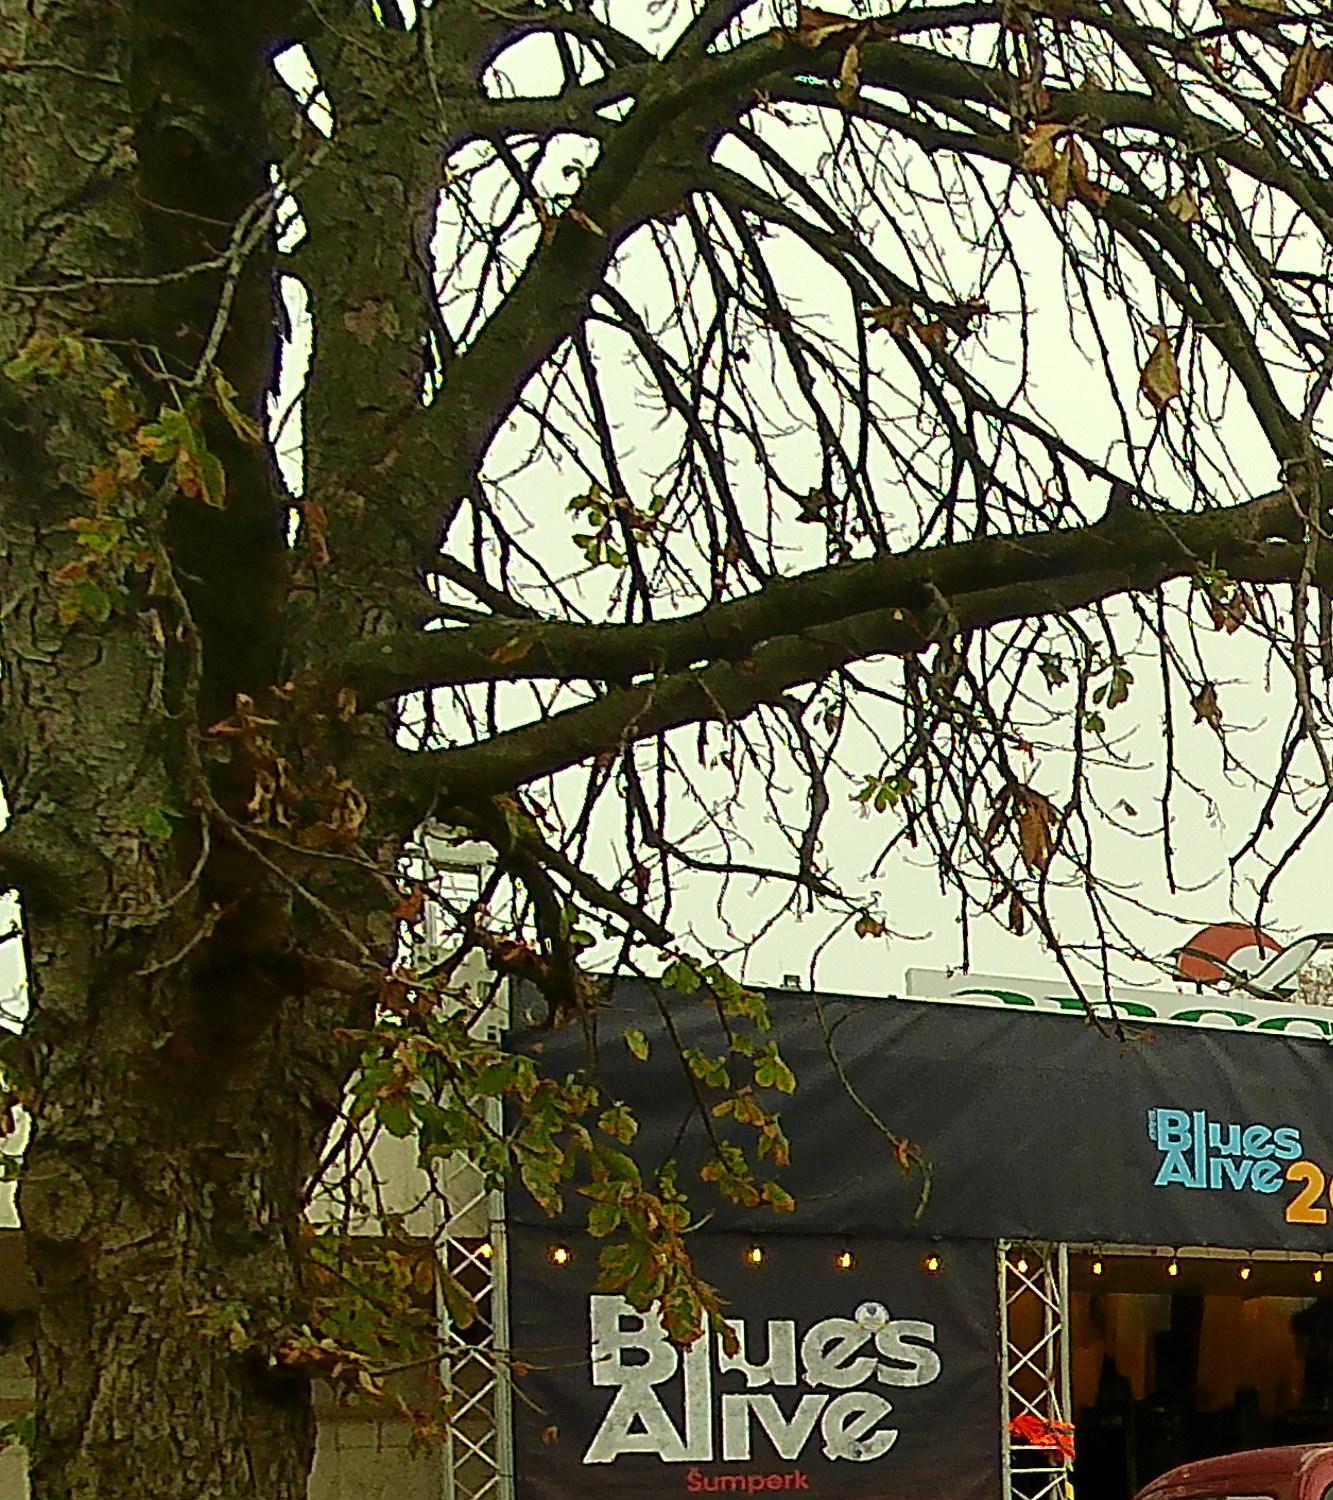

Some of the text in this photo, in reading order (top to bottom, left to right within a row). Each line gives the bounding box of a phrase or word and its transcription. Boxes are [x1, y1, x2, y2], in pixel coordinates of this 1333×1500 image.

[1156, 1108, 1303, 1161] Blues
[1154, 1148, 1284, 1194] Alive
[590, 1294, 942, 1389] Blues
[582, 1384, 899, 1464] Alive
[686, 1467, 810, 1494] Šumperk
